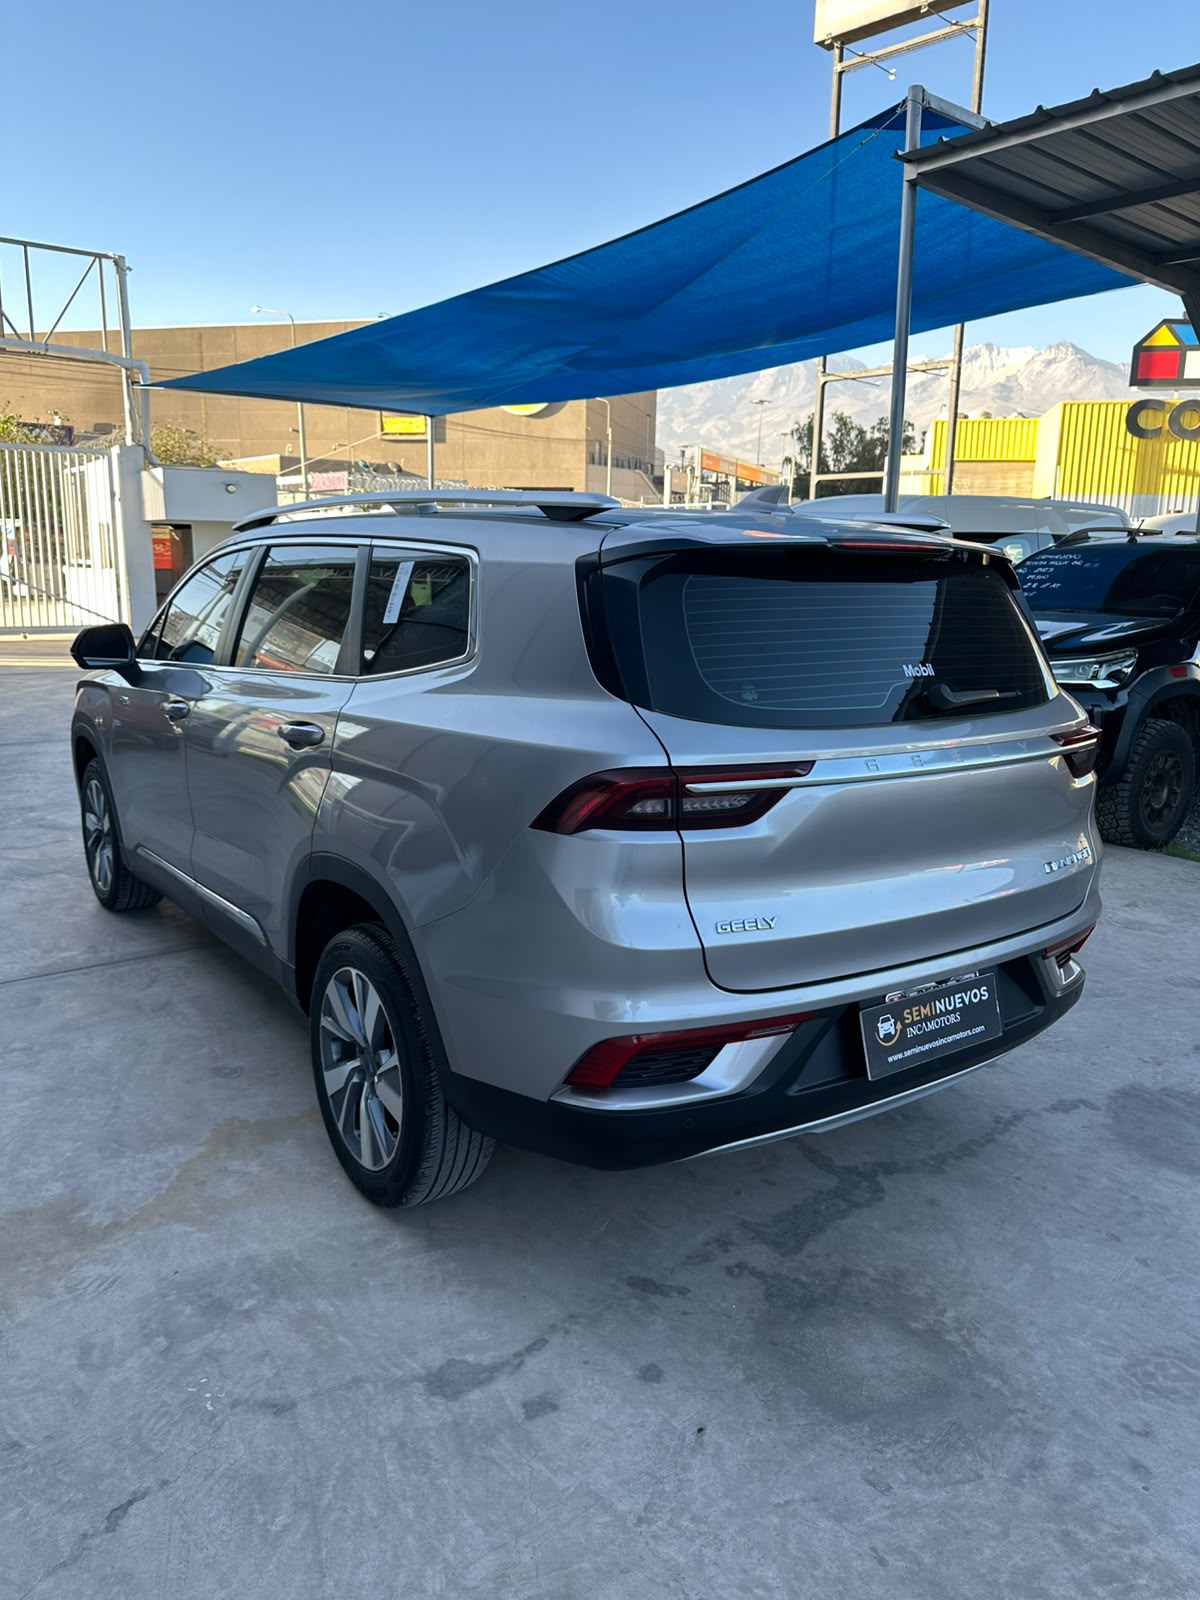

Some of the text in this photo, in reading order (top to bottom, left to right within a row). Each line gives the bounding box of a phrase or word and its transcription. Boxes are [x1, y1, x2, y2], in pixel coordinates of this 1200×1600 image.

[902, 663, 935, 677] Mobil
[715, 916, 778, 934] GEELY
[906, 1011, 961, 1038] INCAMOTORS
[887, 1024, 986, 1063] www.seminuevosincamotors.com
